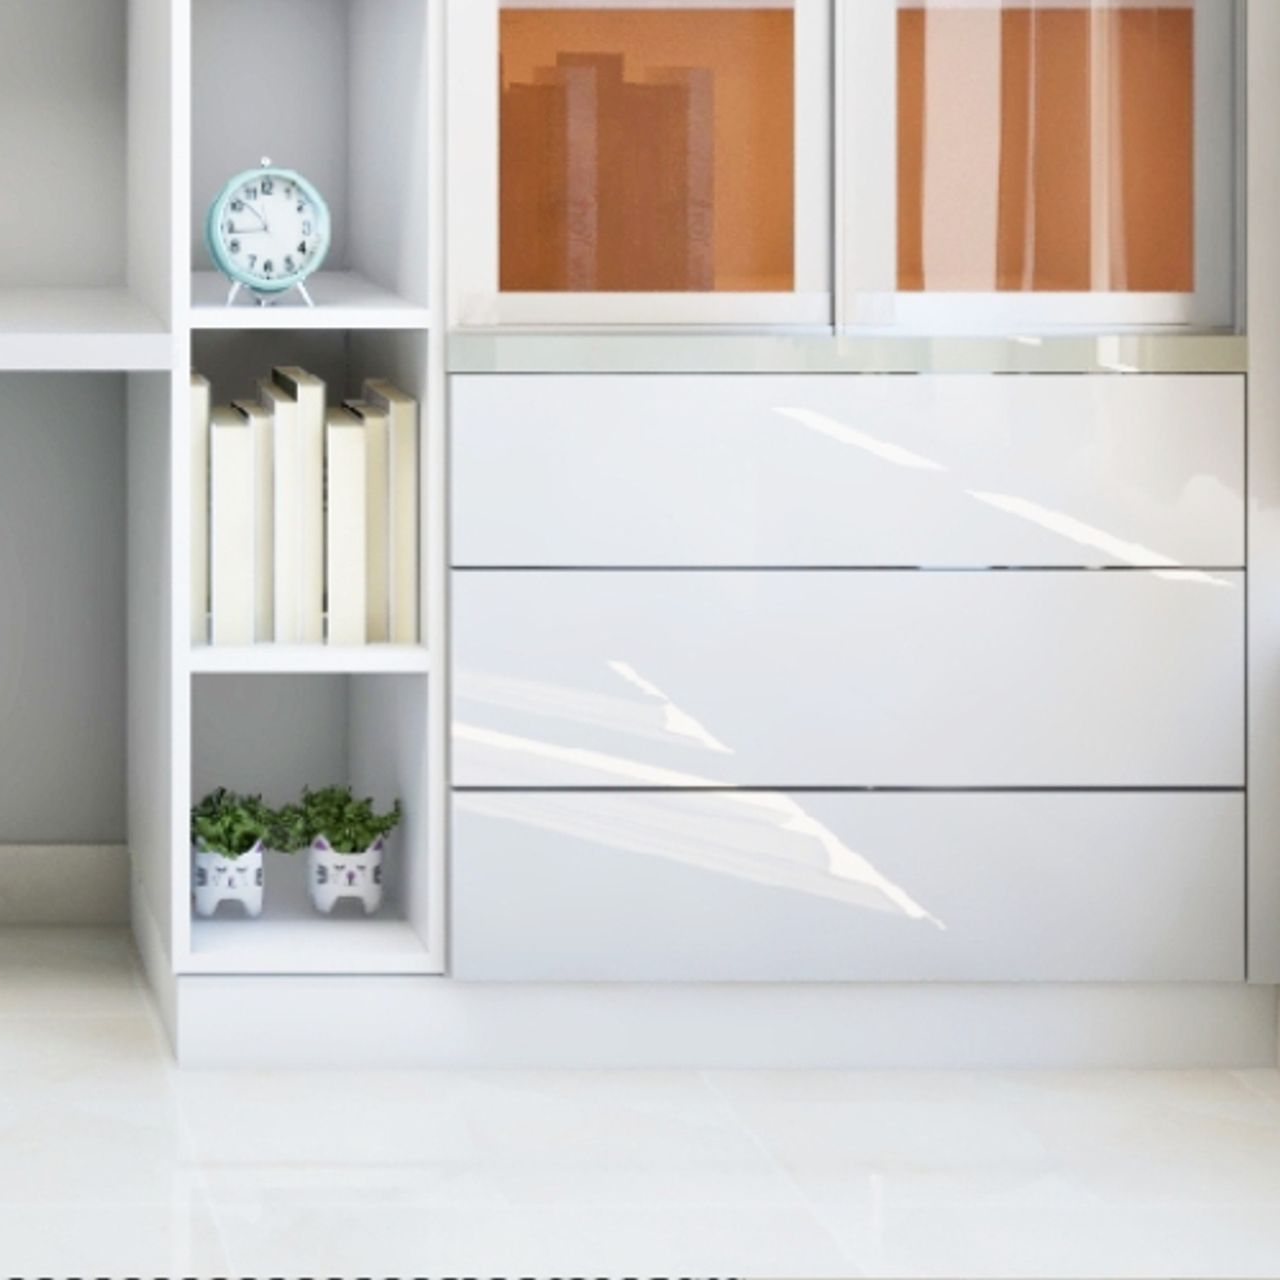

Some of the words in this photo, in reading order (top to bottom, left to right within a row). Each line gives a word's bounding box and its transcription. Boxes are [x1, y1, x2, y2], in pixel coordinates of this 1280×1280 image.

[245, 187, 257, 200] 11
[261, 181, 273, 196] 12
[230, 239, 240, 254] 8
[297, 240, 306, 255] 4
[248, 254, 257, 269] 7
